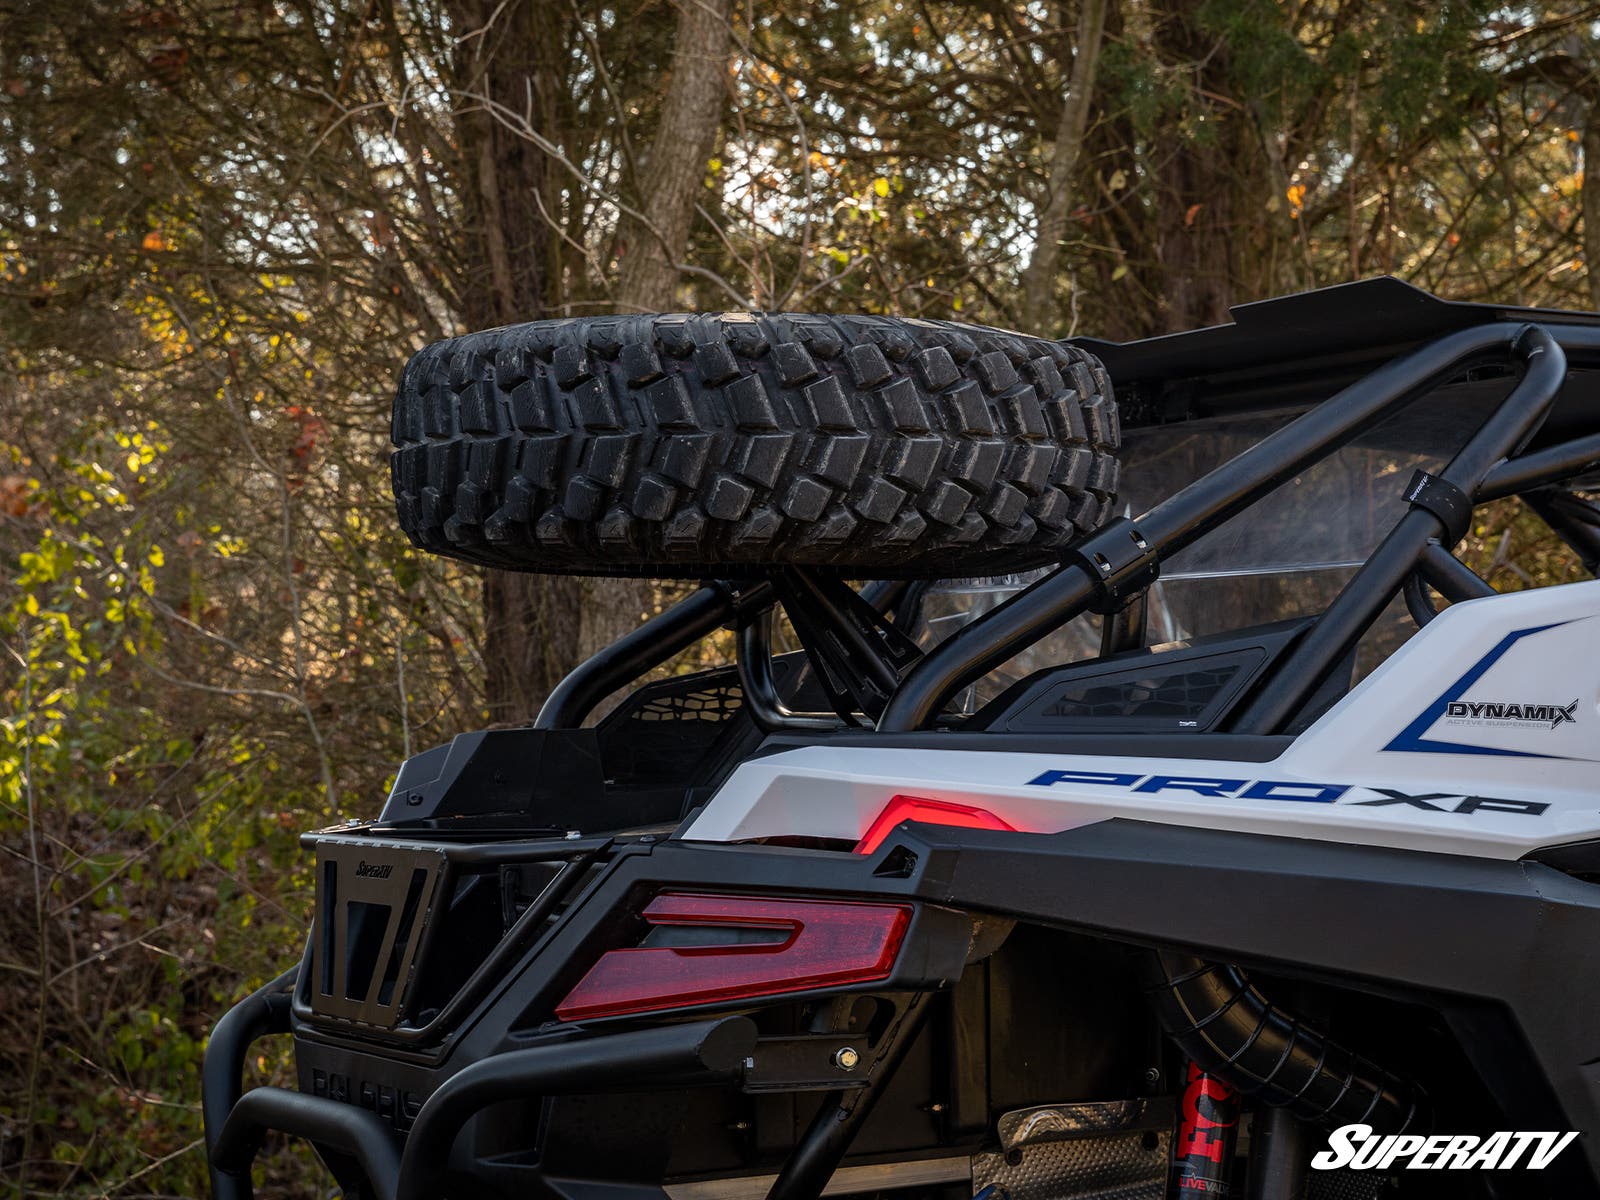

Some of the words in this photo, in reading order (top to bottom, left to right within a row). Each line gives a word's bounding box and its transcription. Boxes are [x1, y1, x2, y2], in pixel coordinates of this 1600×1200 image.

[1446, 698, 1579, 730] DYNAMIX
[1446, 719, 1485, 727] ACTIVE
[1486, 720, 1551, 729] SUSPENSION
[1025, 769, 1353, 804] PRO
[1344, 787, 1552, 816] XP
